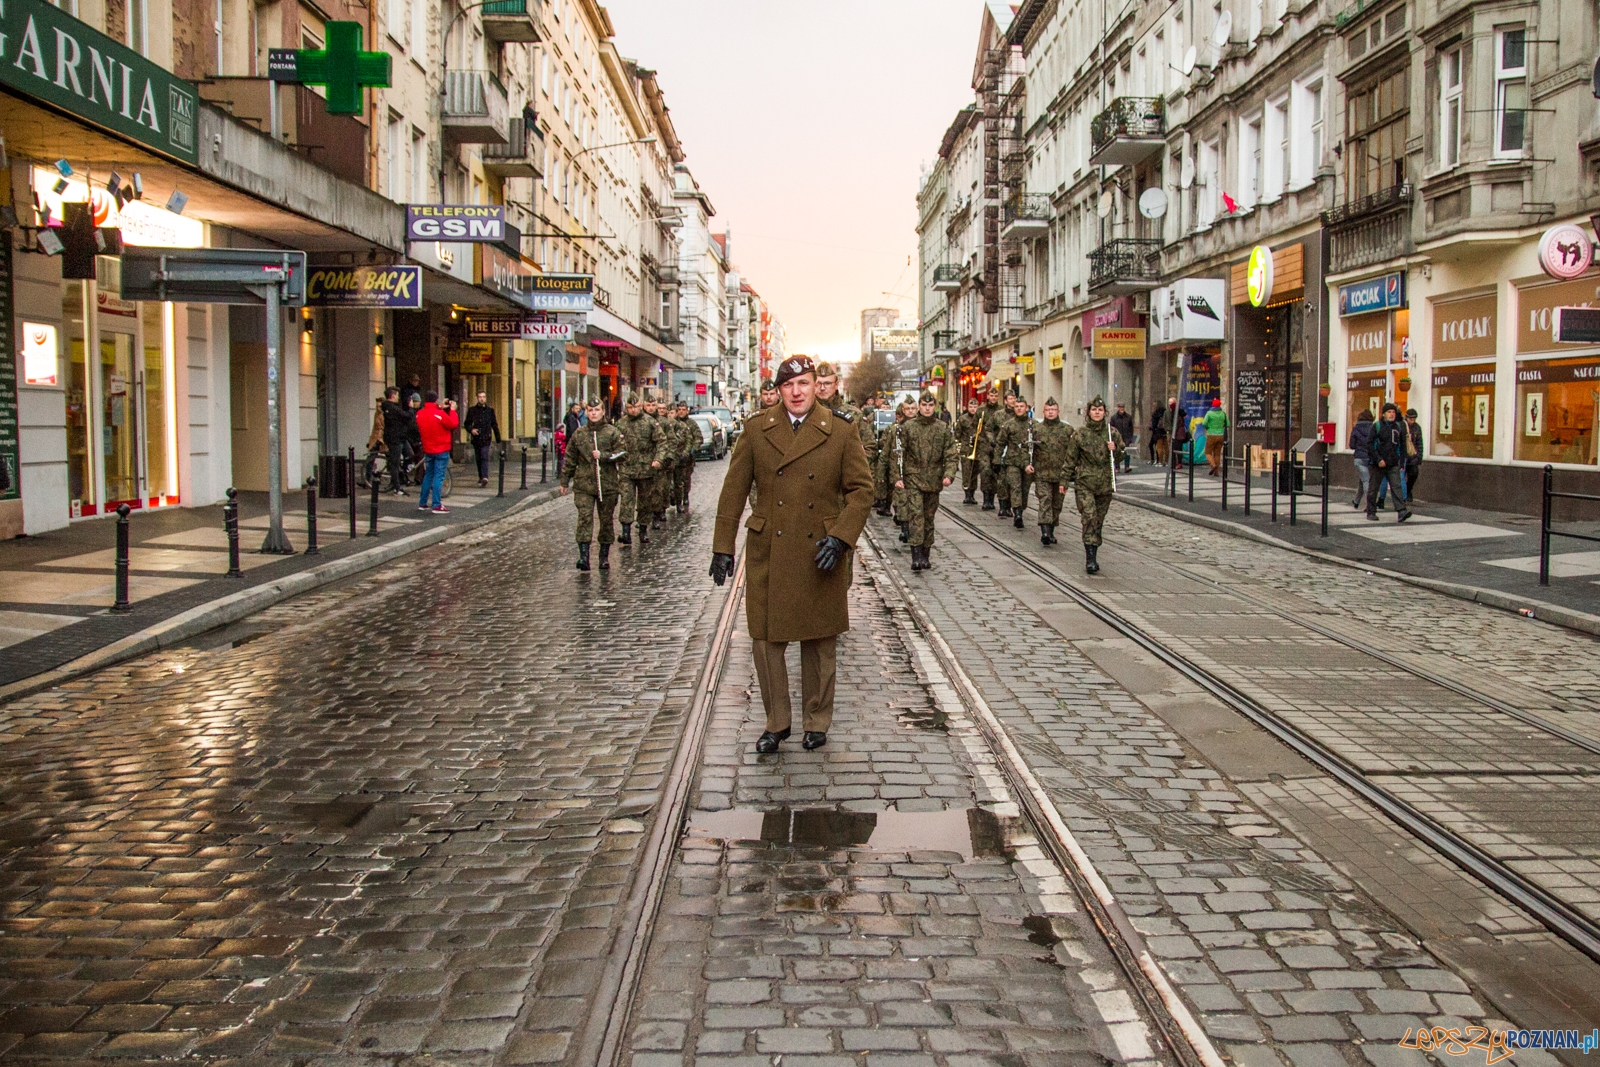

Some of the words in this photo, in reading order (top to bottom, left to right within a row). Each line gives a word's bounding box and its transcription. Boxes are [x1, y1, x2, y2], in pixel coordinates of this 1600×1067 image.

[0, 14, 160, 133] ARNIA
[411, 206, 500, 217] TELEFONY
[412, 219, 500, 237] GSM
[307, 270, 359, 299] COME
[364, 270, 415, 299] BACK
[536, 276, 589, 291] fotograf
[534, 295, 569, 307] KSERO
[1351, 286, 1380, 307] KOCIAK
[469, 322, 488, 332] THE
[492, 321, 516, 332] BEST
[523, 324, 568, 334] KSERO
[1442, 316, 1492, 342] KOCIAK
[1351, 330, 1386, 352] KOCIAK
[1519, 370, 1542, 380] CIASTA
